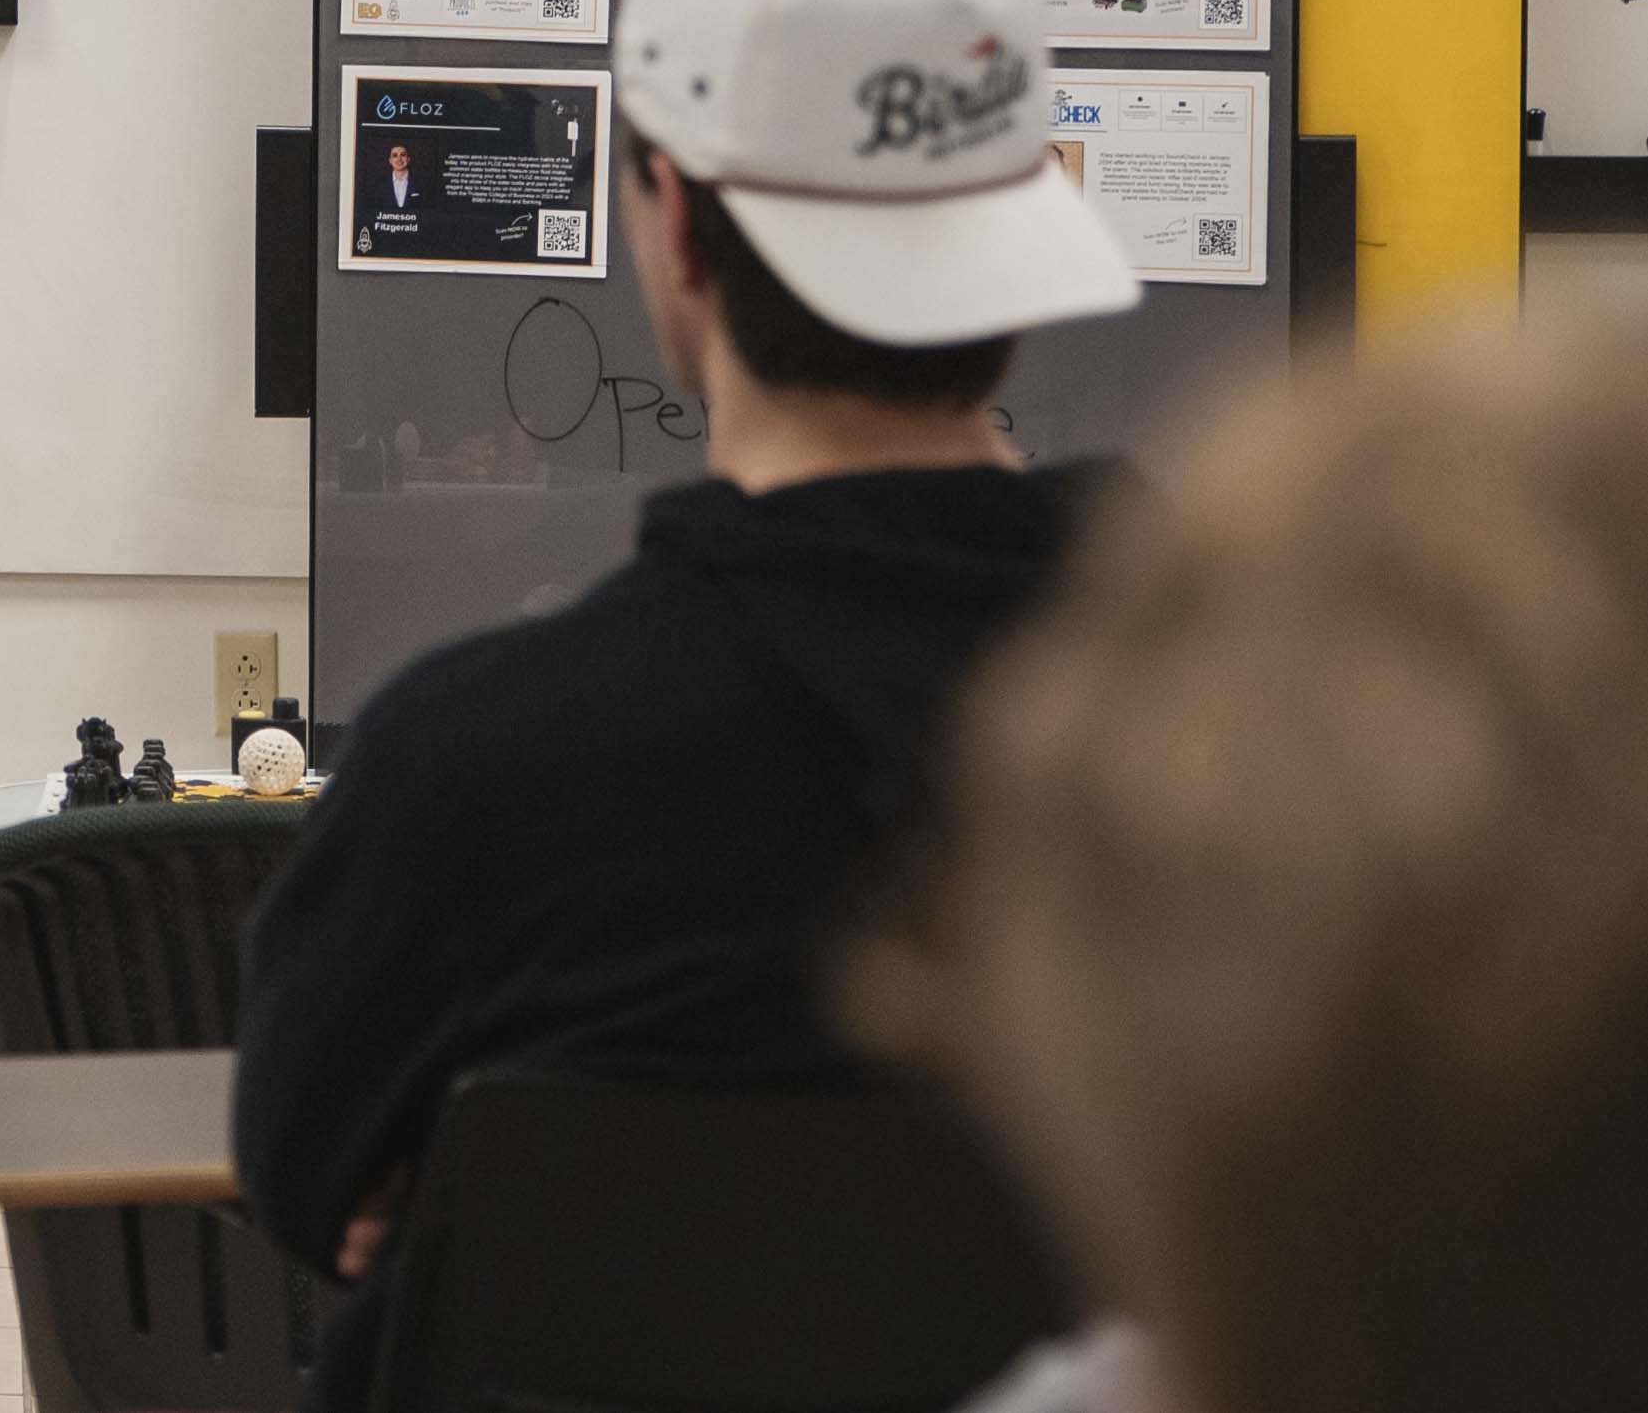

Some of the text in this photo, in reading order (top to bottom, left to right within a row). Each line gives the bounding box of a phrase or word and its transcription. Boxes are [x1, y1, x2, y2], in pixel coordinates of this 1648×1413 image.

[400, 102, 444, 116] FLOZ
[376, 212, 416, 221] Jameson
[375, 223, 419, 233] Fitzgerald
